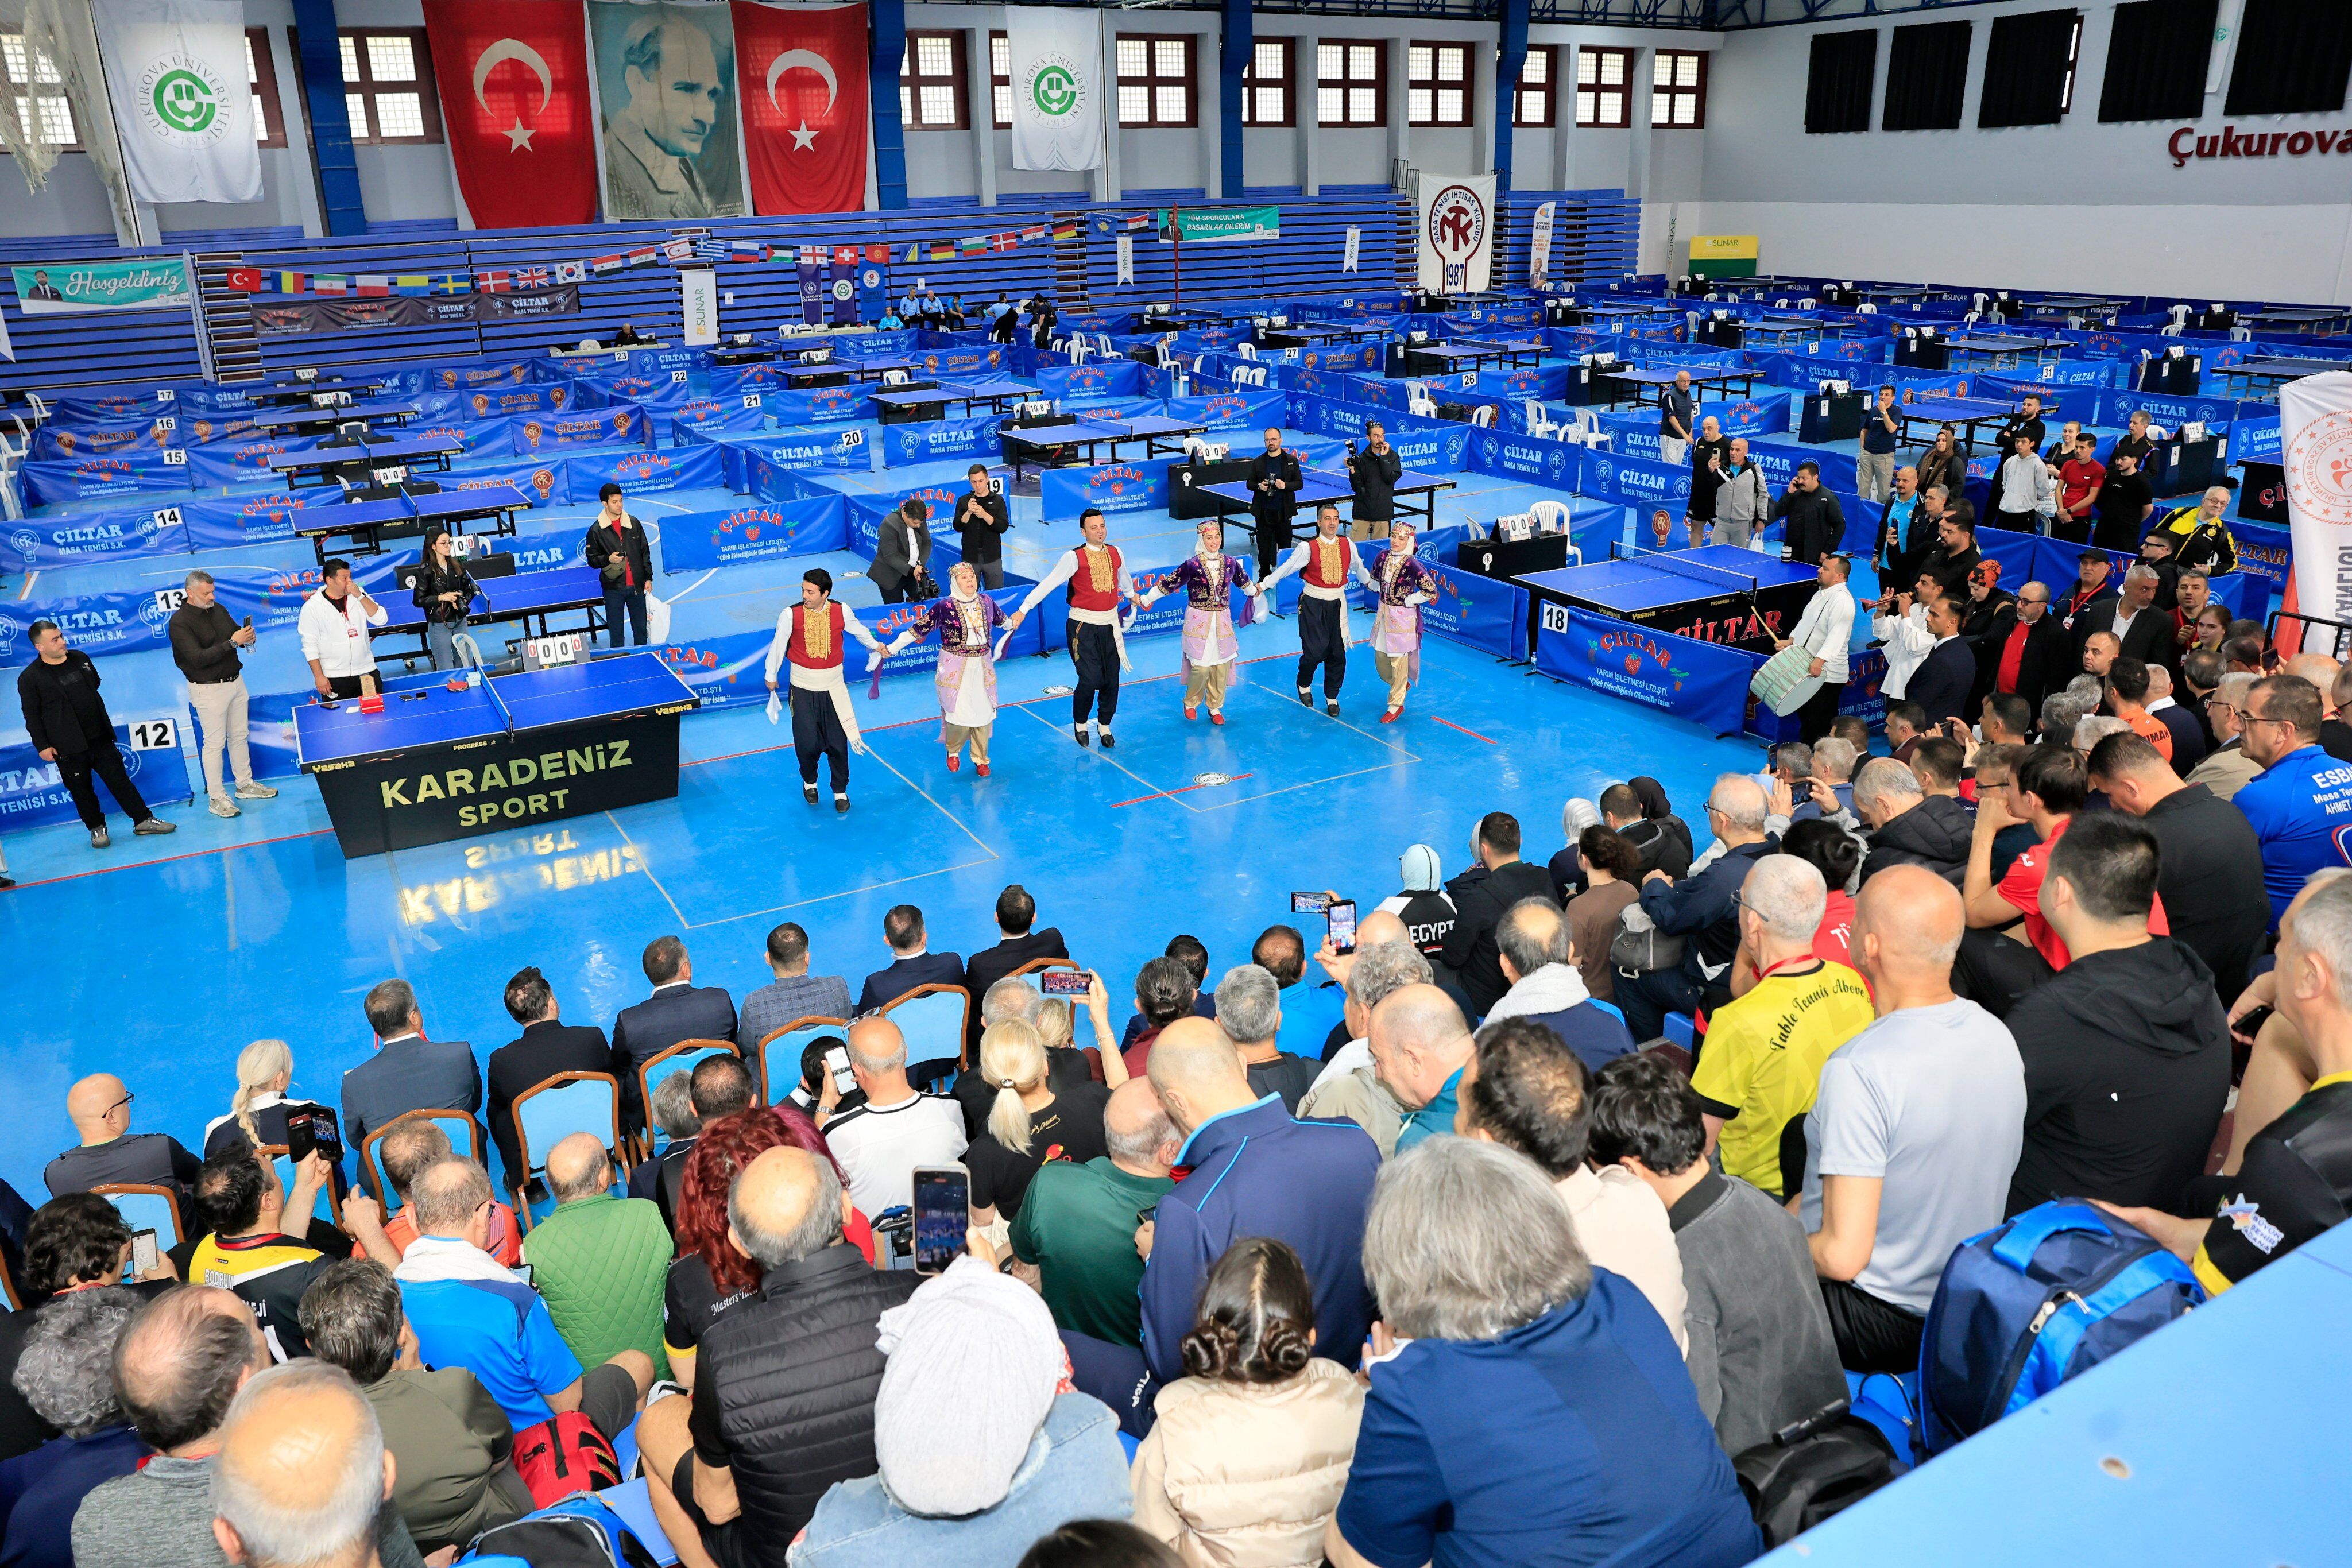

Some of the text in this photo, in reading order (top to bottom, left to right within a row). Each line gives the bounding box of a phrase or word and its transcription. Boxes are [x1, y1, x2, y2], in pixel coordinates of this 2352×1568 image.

[1025, 57, 1047, 119] ÇUKUROVA
[138, 61, 169, 139] ÇUKUROVA
[1046, 118, 1067, 126] 1973
[180, 133, 206, 145] 1973
[1451, 189, 1475, 206] İHTİSAS
[1434, 193, 1450, 219] TENİSİ
[1433, 219, 1441, 243] MASA
[1668, 218, 1676, 260] SUNAR
[1446, 263, 1464, 287] 1987
[438, 304, 465, 314] ÇİLTAR
[512, 297, 550, 309] ÇİLTAR
[695, 287, 705, 326] SUNAR
[1371, 302, 1393, 311] ÇİLTAR
[1503, 315, 1526, 324] ÇİLTAR
[1612, 324, 1622, 333] 33
[862, 338, 892, 348] ÇİLTAR
[1167, 332, 1177, 340] 28
[2088, 334, 2122, 346] ÇİLTAR
[1286, 349, 1297, 357] 27
[1645, 347, 1674, 359] ÇİLTAR
[1810, 343, 1817, 353] 32
[1839, 340, 1865, 354] ÇİLTAR
[616, 352, 628, 361] 23
[659, 353, 692, 363] ÇİLTAR
[947, 354, 980, 366] ÇİLTAR
[1325, 354, 1356, 366] ÇİLTAR
[466, 369, 501, 382] ÇİLTAR
[674, 371, 686, 381] 22
[741, 364, 776, 377] ÇİLTAR
[1069, 367, 1105, 381] ÇİLTAR
[1507, 370, 1539, 384] ÇİLTAR
[1808, 366, 1840, 380] ÇİLTAR
[2044, 367, 2052, 377] 31
[2069, 370, 2095, 382] ÇİLTAR
[613, 377, 651, 390] ÇİLTAR
[1464, 374, 1475, 386] 26
[160, 391, 172, 400] 17
[499, 393, 539, 407] ÇİLTAR
[745, 396, 759, 406] 21
[812, 389, 852, 404] ÇİLTAR
[678, 400, 721, 415] ÇİLTAR
[1030, 403, 1044, 413] 10 8
[1206, 396, 1247, 412] ÇİLTAR
[1727, 402, 1760, 417] ÇİLTAR
[2141, 401, 2187, 417] ÇİLTAR
[159, 419, 173, 429] 16
[1333, 409, 1361, 425] ÇİLTAR
[2155, 416, 2173, 427] TENİSİ
[554, 420, 602, 436] ÇİLTAR
[88, 430, 138, 446] ÇİLTAR
[844, 432, 860, 446] 20
[928, 429, 976, 447] ÇİLTAR
[1626, 431, 1661, 448] ÇİLTA
[2253, 427, 2283, 445] ÇİLTAR
[234, 444, 286, 462] ÇİLTAR
[772, 446, 823, 462] ÇİLTAR
[946, 444, 964, 453] TENİSİ
[1397, 442, 1438, 459] ÇİLTAR
[1504, 444, 1542, 463] ÇİLTAR
[1625, 447, 1657, 458] MASA TENİSİ
[166, 452, 183, 463] 15
[617, 453, 671, 473] ÇİLTAR
[792, 459, 824, 469] TENİSİ S.K.
[1413, 456, 1437, 467] TENİSİ S.K.
[76, 459, 132, 476] ÇİLTAR
[1503, 460, 1517, 470] MASA
[1516, 462, 1531, 473] TENİSİ
[1090, 466, 1144, 487] ÇİLTAR
[1620, 469, 1665, 490] ÇİLTAR
[1091, 495, 1128, 505] TARIM İŞLETMESİ
[1620, 487, 1653, 501] MASA TENİSİ
[242, 496, 305, 516] ÇİLTAR
[157, 510, 179, 526] 14
[719, 509, 783, 535] ÇİLTAR
[52, 524, 124, 545] ÇİLTAR
[58, 541, 126, 556] MASA TENİSİ S.K.
[721, 541, 765, 552] TARIM İŞLETMESİ
[758, 547, 777, 556] Güvenilir
[161, 591, 183, 610] 13
[272, 606, 291, 615] TARIM
[1598, 606, 1622, 619] Yasaka
[1631, 610, 1656, 620] Yasaka
[1151, 619, 1174, 629] Güvenilir
[1546, 607, 1565, 630] 18
[78, 628, 105, 645] TENİSİ
[542, 642, 569, 659] 0 0
[900, 644, 935, 657] İŞLETMESİ
[1600, 629, 1672, 671] ÇİLTAR
[890, 656, 927, 669] Fideciliğinde
[1596, 667, 1614, 680] TARIM
[1614, 671, 1646, 689] İŞLETMESİ
[1603, 679, 1658, 704] Fideciliğinde Güvenilir
[655, 703, 693, 715] Yasaka
[134, 723, 171, 748] 12
[453, 741, 488, 752] PROGRESS
[312, 760, 355, 773] Yasaka
[2312, 792, 2341, 805] Masa
[459, 788, 570, 827] SPORT
[2324, 799, 2352, 816] AHMET
[1409, 920, 1456, 943] EGYPT
[1792, 984, 1829, 1014] Tennis
[1832, 978, 1865, 998] Above
[204, 1268, 235, 1291] BODRUM
[711, 1293, 740, 1317] Masters
